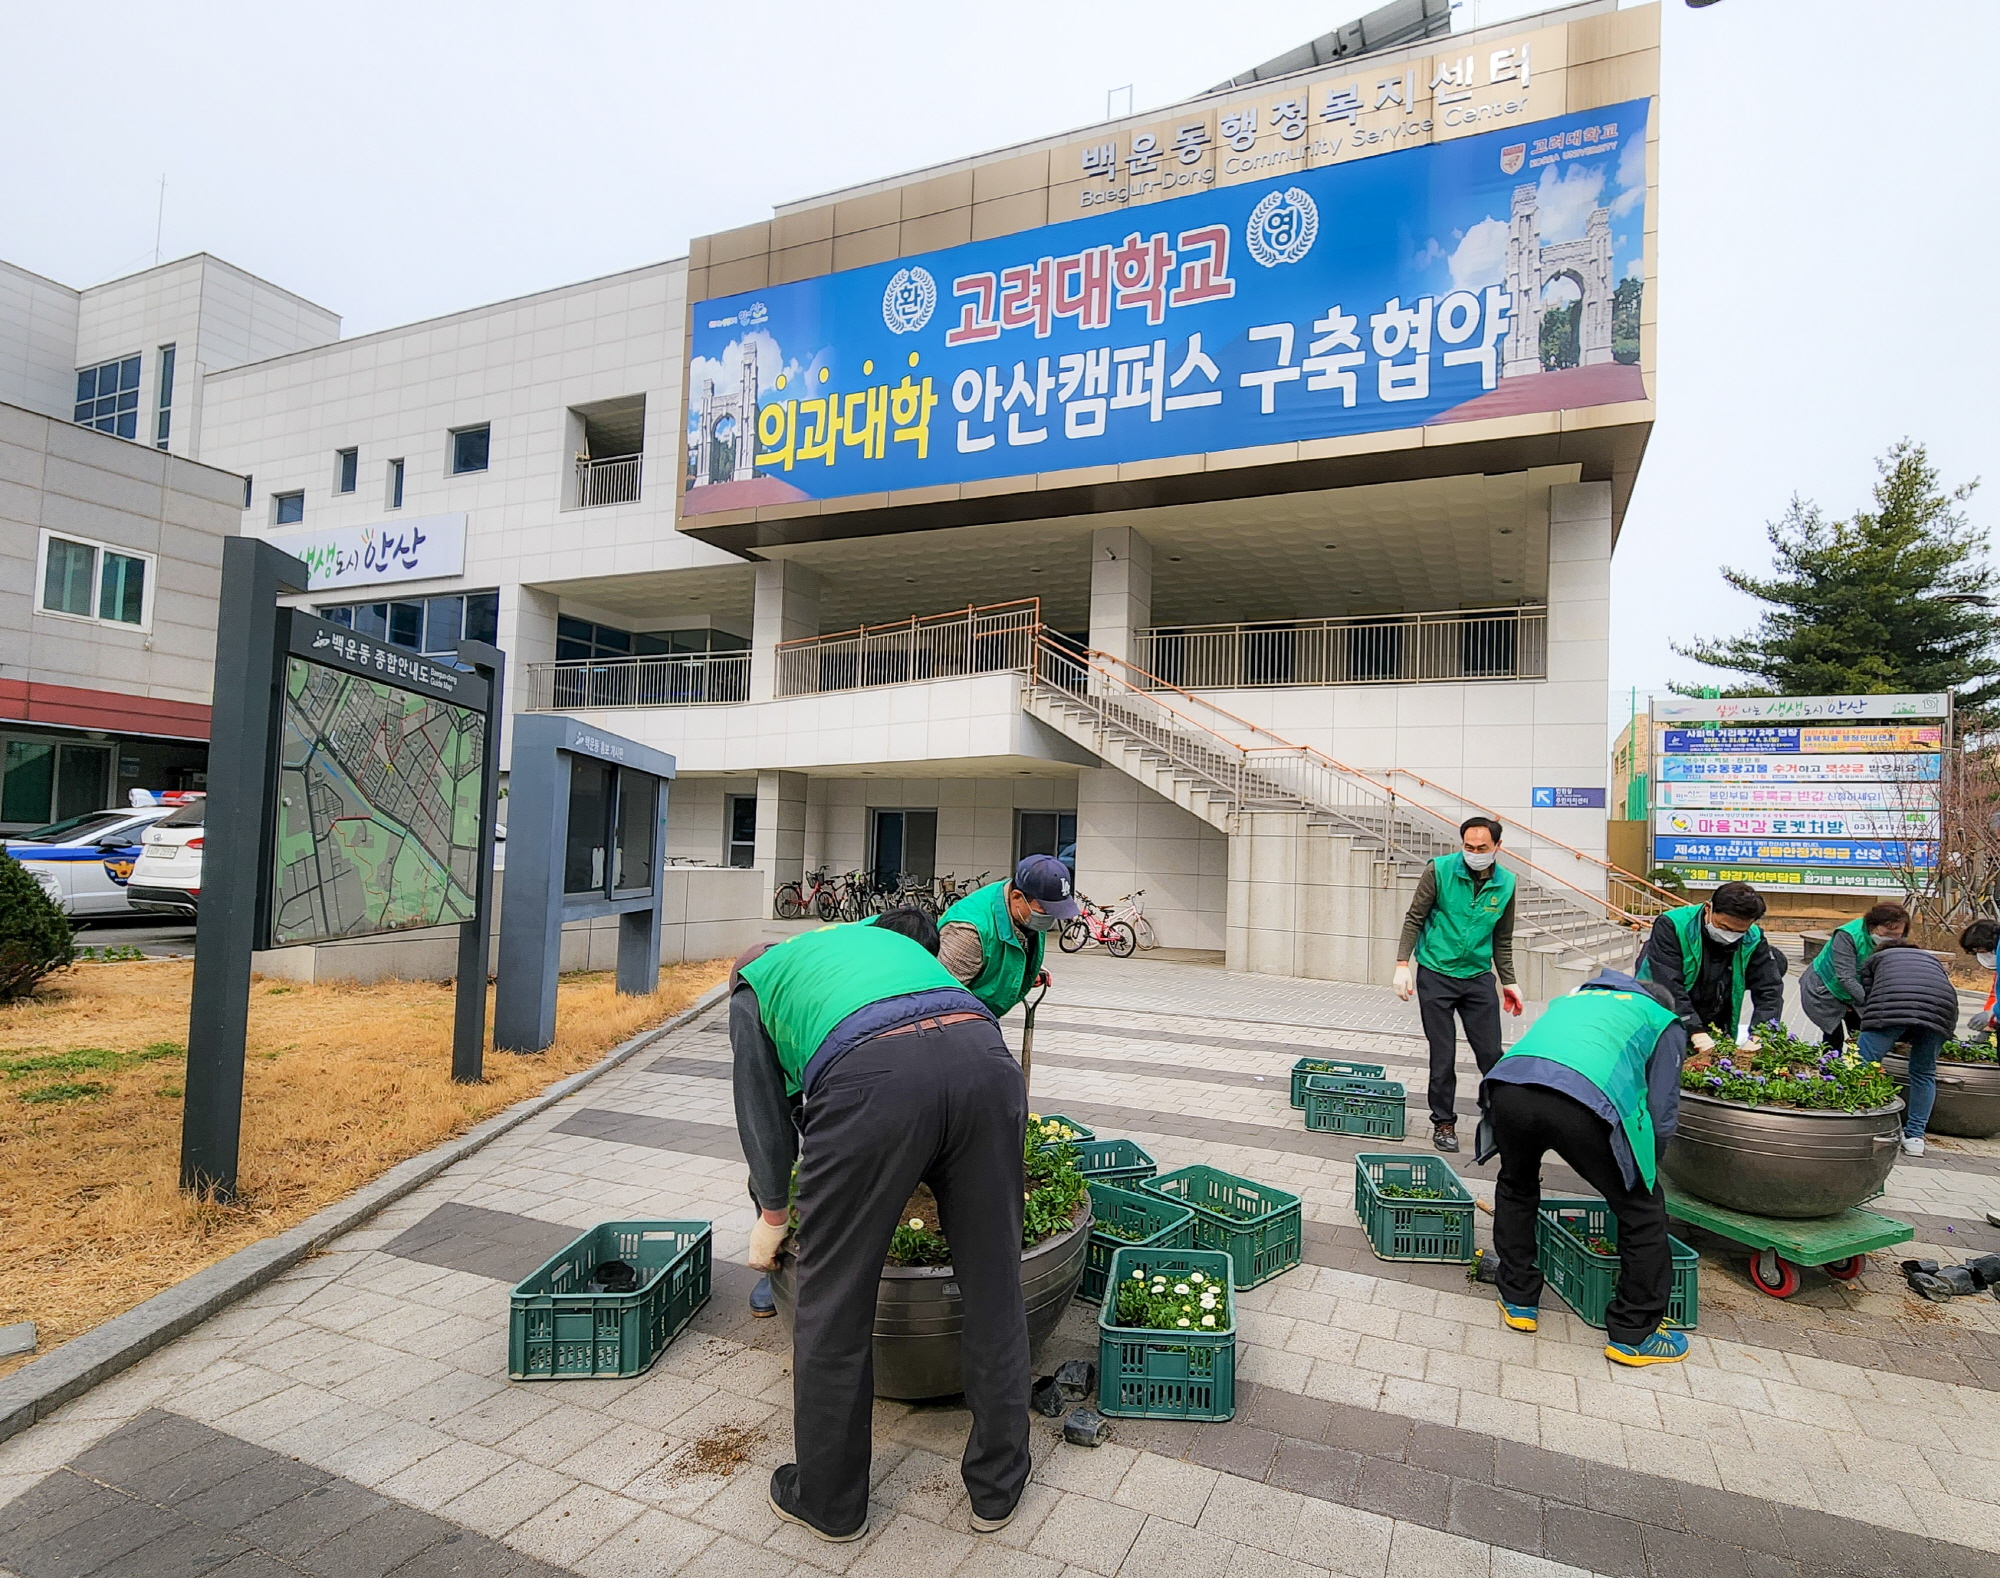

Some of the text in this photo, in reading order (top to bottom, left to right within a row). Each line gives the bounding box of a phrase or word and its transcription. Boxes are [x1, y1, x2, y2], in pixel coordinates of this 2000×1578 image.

[1081, 42, 1531, 182] 백운동행정복지센터
[1080, 95, 1529, 208] Baegun-Dong Community Service Center
[1530, 123, 1618, 155] 고려대학교
[1264, 205, 1297, 249] 영
[898, 283, 923, 317] 환
[945, 224, 1235, 347] 고려대학교
[755, 284, 1510, 472] 의과대학 안산캠퍼스 구축협약
[364, 527, 426, 573] 안산
[332, 633, 429, 683] 백운동 종합안내도
[430, 678, 453, 692] Guide Map
[1828, 700, 1868, 714] 안산
[1686, 729, 1715, 738] 사회적
[1718, 729, 1756, 737] 거리두기
[1683, 764, 1768, 773] 불법유동광고물
[1773, 764, 1821, 773] 수거하고
[1753, 791, 1792, 801] 등록금
[1797, 791, 1824, 801] 반값
[1699, 820, 1844, 834] 마음건강 로켓처방
[1674, 844, 1711, 856] 제4차
[1714, 845, 1752, 857] 안산시
[1757, 846, 1850, 859] 생활안정지원금
[1720, 870, 1801, 883] 환경개선부담금
[1804, 875, 1833, 884] 정기분
[1835, 876, 1865, 886] 납부의
